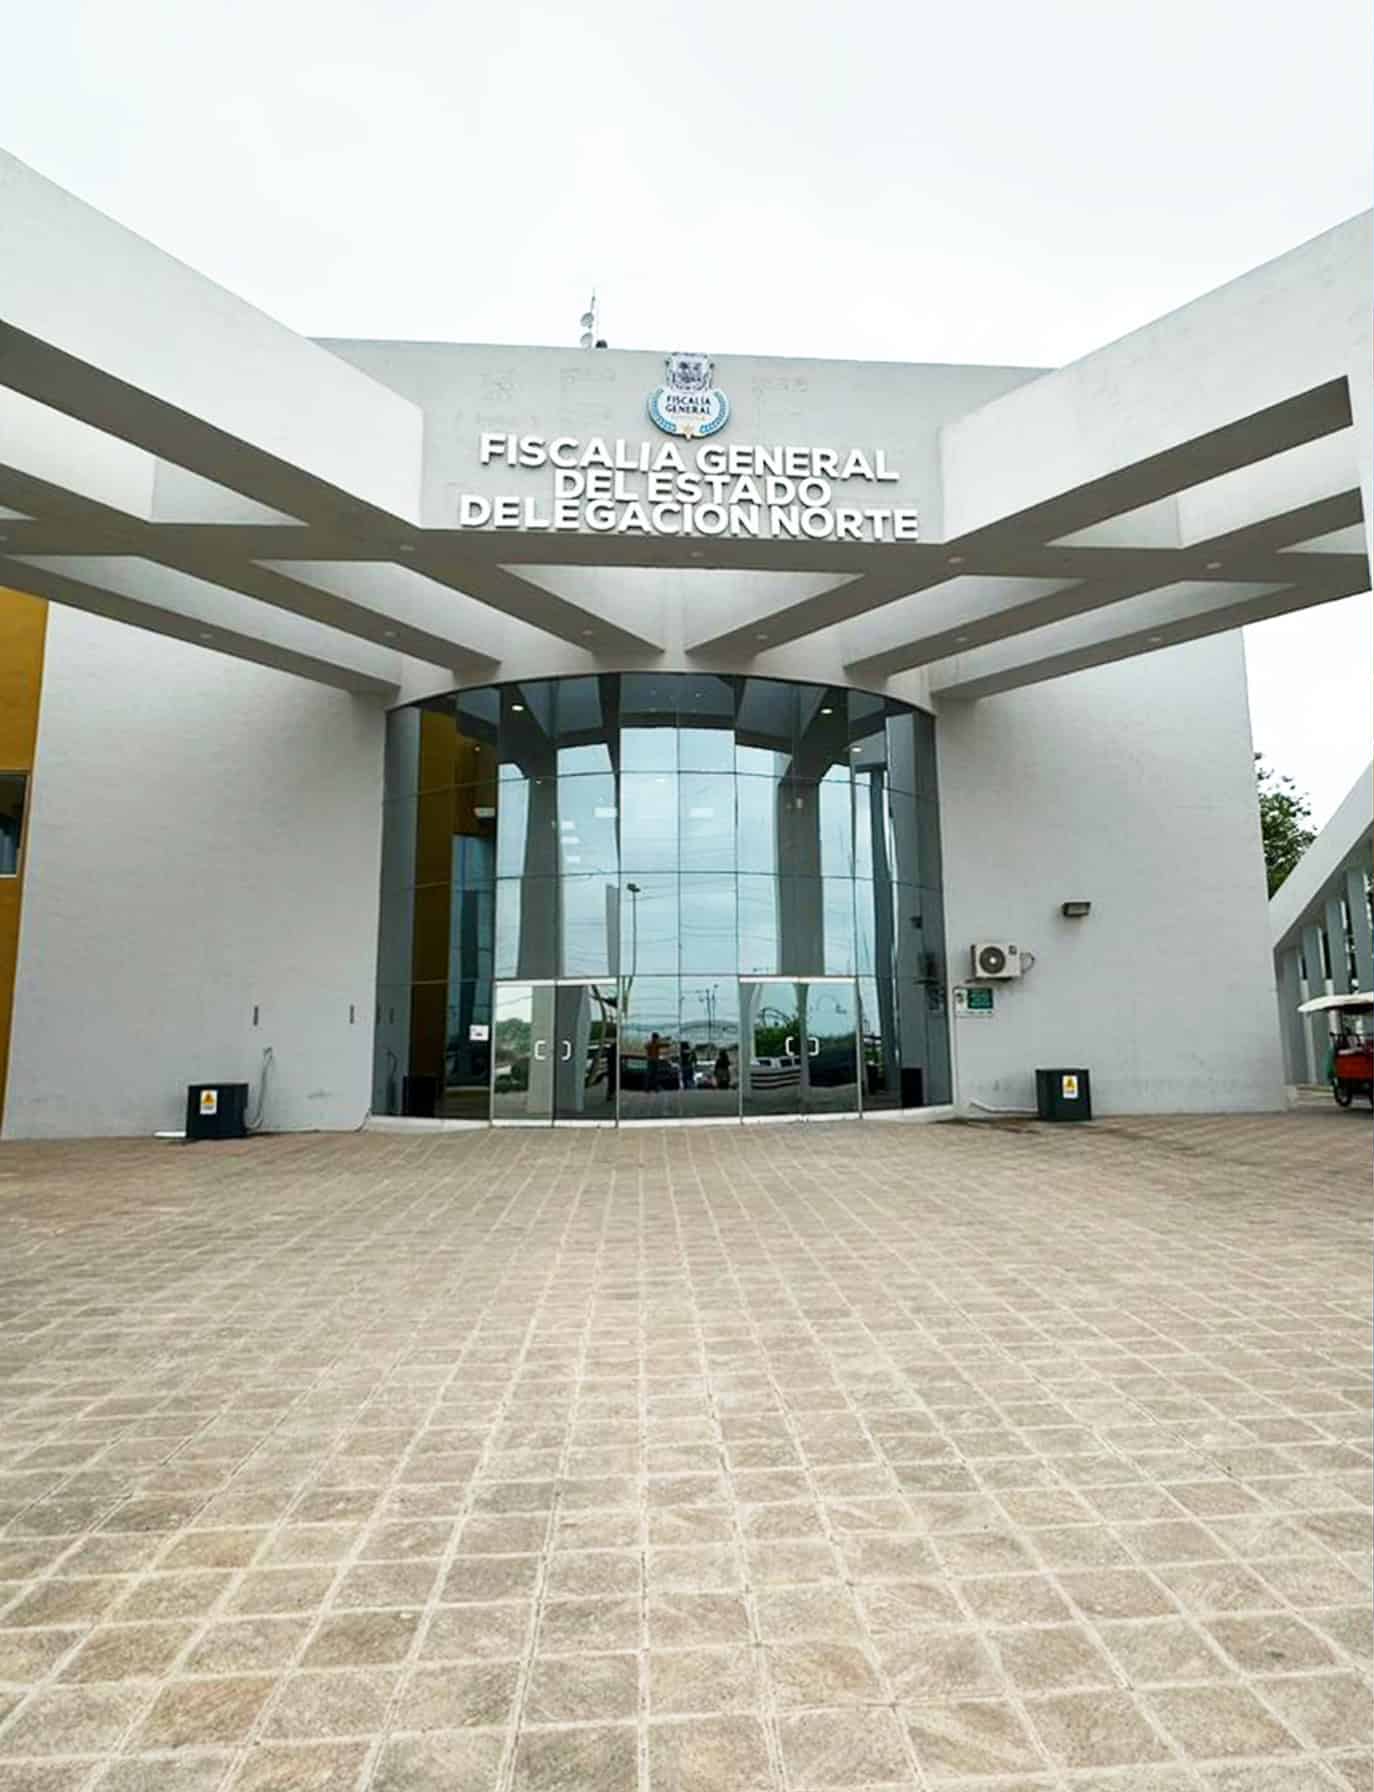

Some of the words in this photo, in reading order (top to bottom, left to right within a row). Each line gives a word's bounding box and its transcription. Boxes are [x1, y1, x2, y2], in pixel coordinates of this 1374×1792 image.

[665, 404, 711, 415] GENERAL
[666, 395, 711, 405] FISCALIA
[480, 432, 686, 474] FISCALIA
[696, 444, 900, 483] GENERAL
[554, 468, 639, 503] DEL
[648, 471, 832, 508] ESTADO
[460, 494, 760, 537] DELEGACION
[771, 505, 919, 541] NORTE
